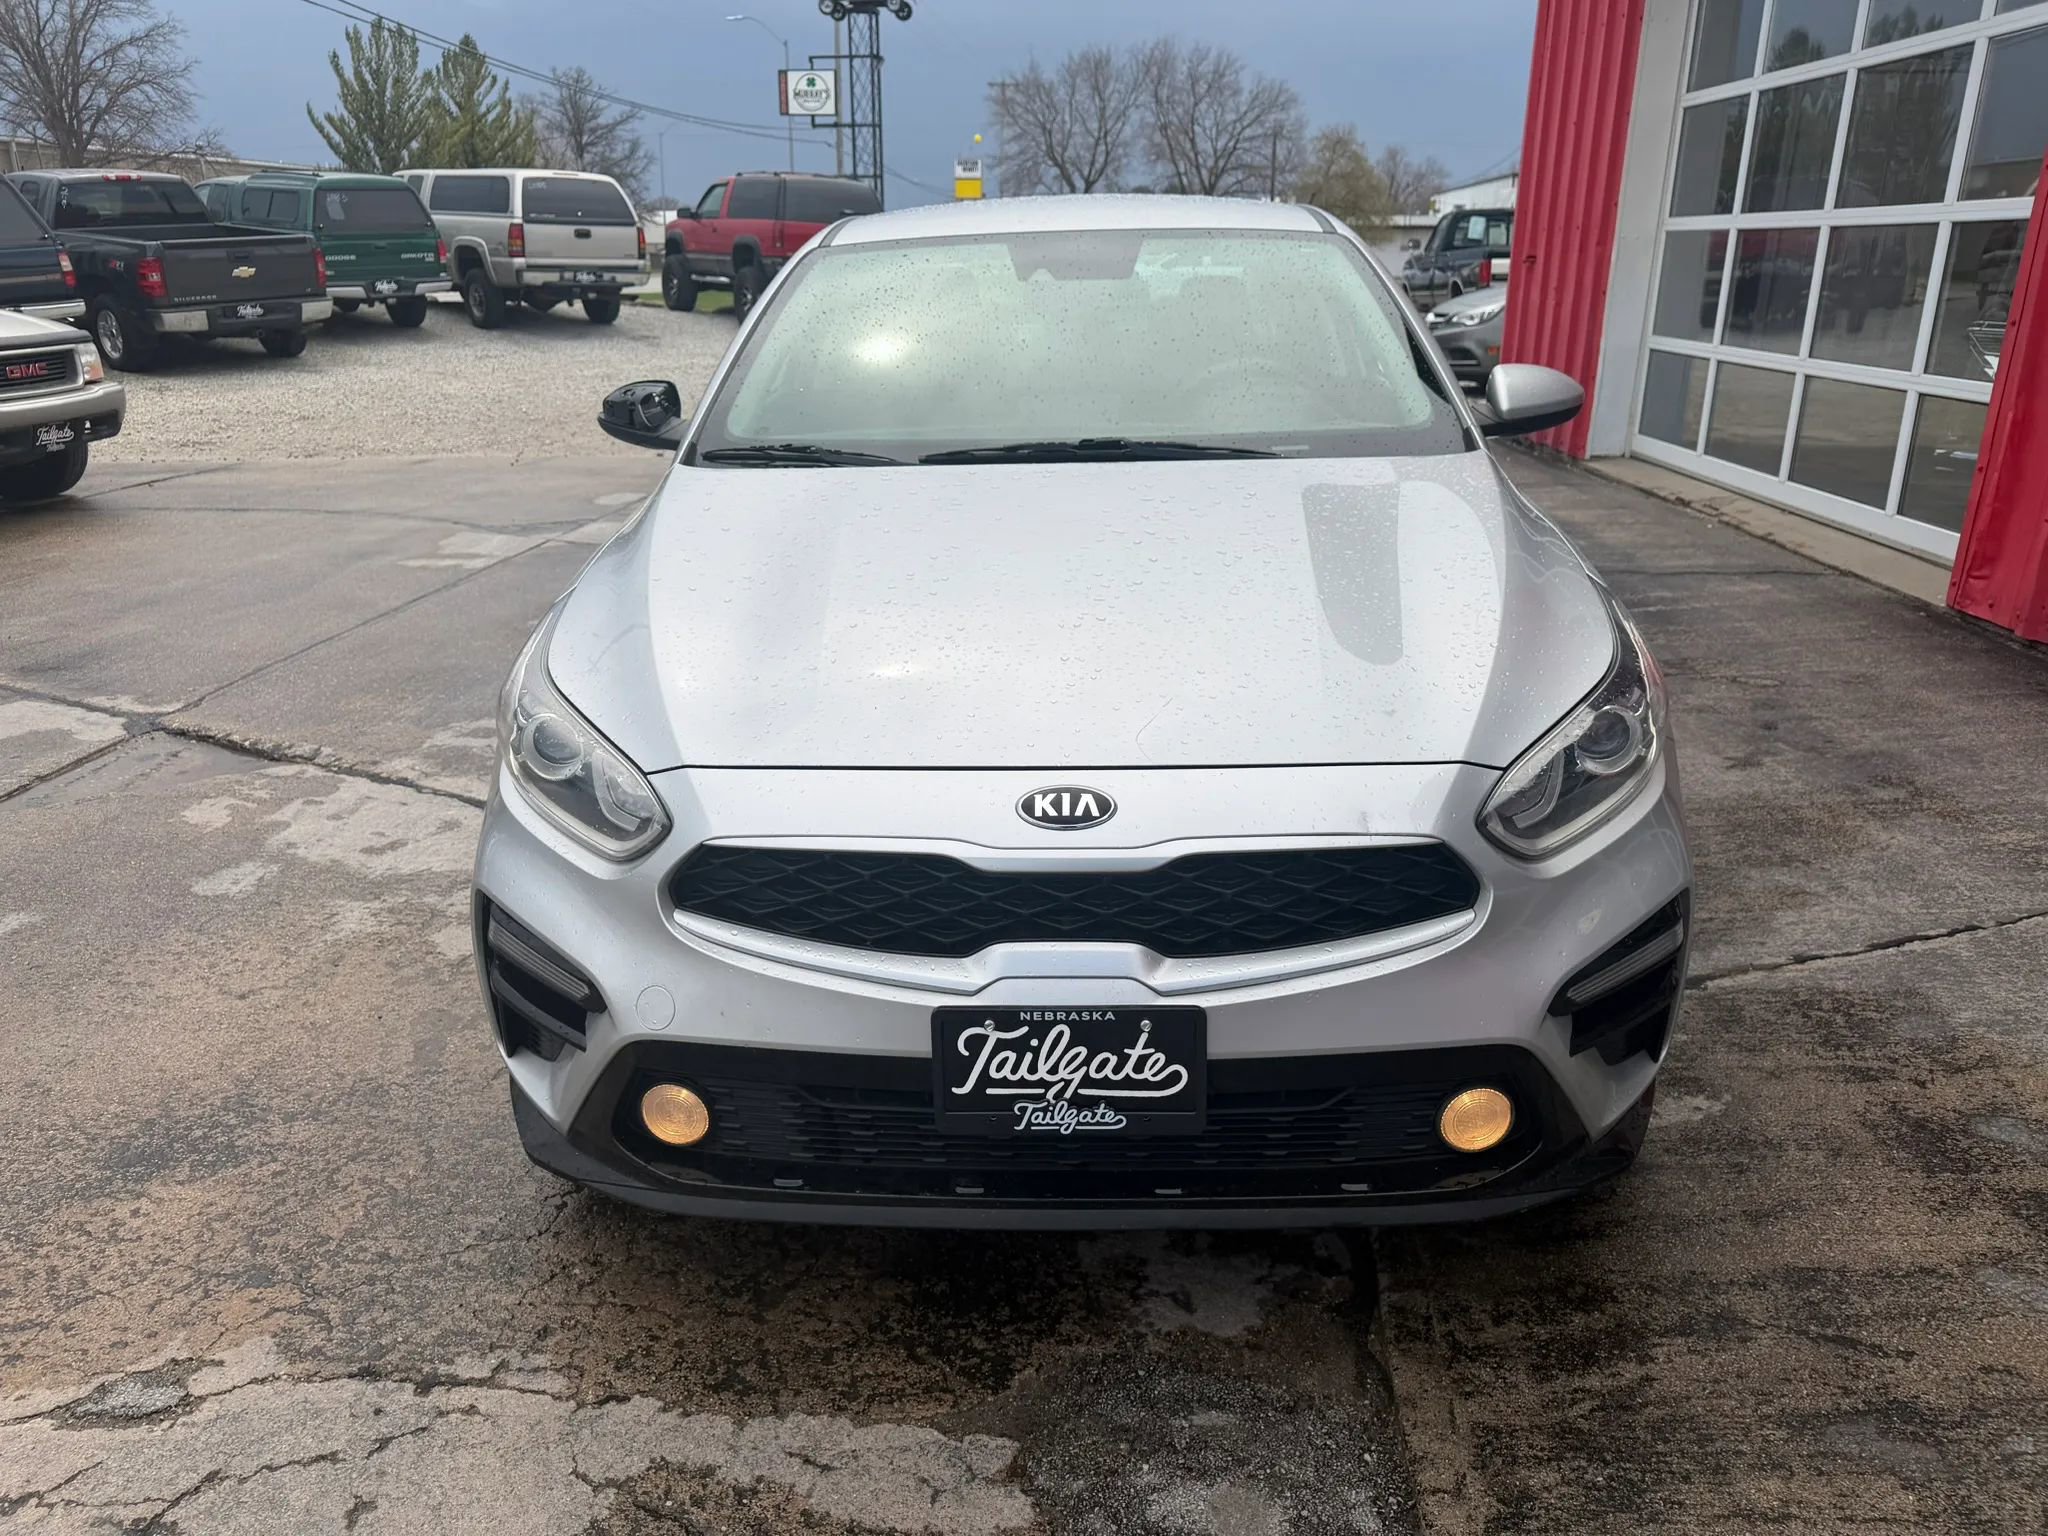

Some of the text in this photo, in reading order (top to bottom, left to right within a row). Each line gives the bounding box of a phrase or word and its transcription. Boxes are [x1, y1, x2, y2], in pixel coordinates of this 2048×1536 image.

[6, 362, 49, 381] GMC
[36, 422, 75, 446] Tailgate
[1033, 792, 1100, 817] KIA
[1019, 1011, 1116, 1021] NEBRASKA
[951, 1023, 1189, 1103] Tailgate
[1013, 1100, 1128, 1135] Tailgate
